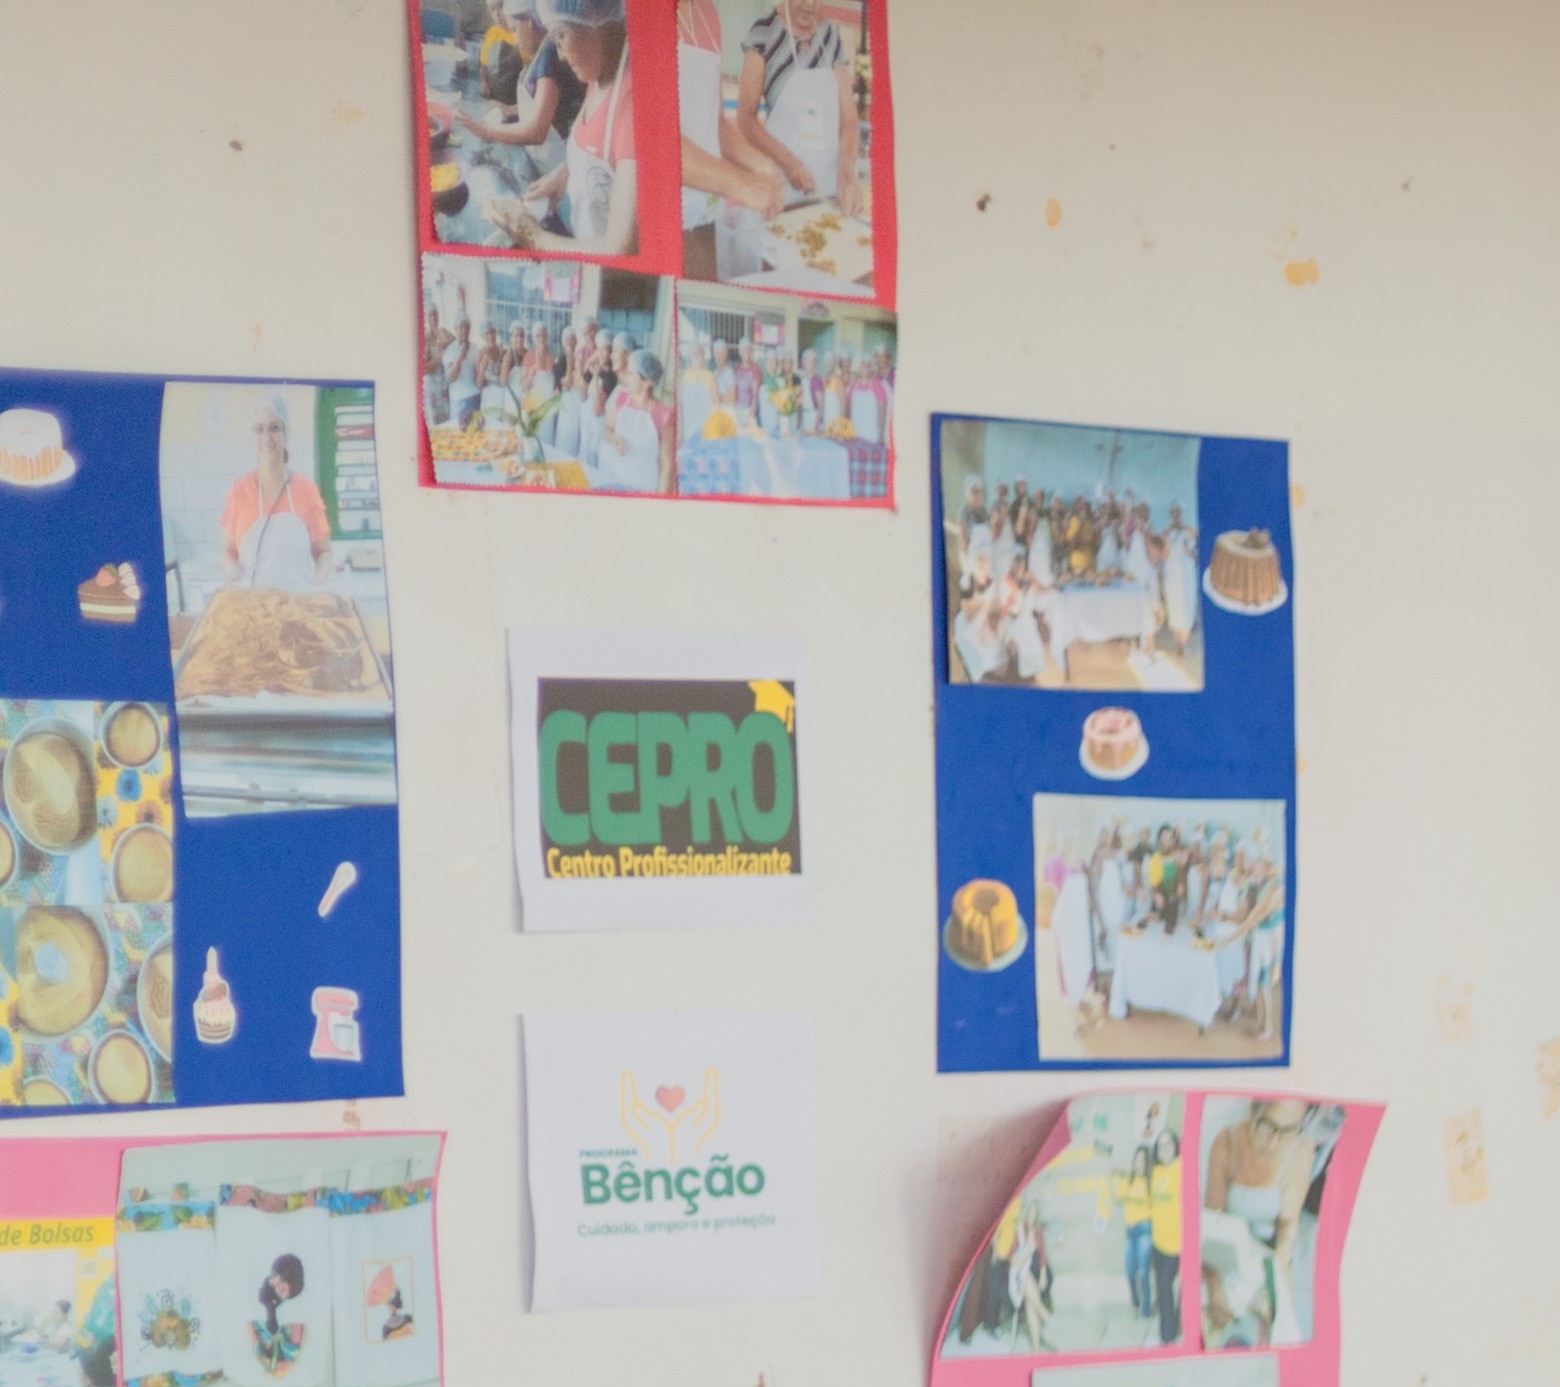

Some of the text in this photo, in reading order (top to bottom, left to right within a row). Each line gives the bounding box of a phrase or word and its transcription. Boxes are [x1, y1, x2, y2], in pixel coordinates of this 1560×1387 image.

[540, 709, 794, 845] CEPRO
[547, 846, 792, 879] Centro Profissionalizante
[580, 1154, 765, 1216] Bênção
[29, 1222, 94, 1244] Bolsas
[714, 1213, 776, 1232] proteção
